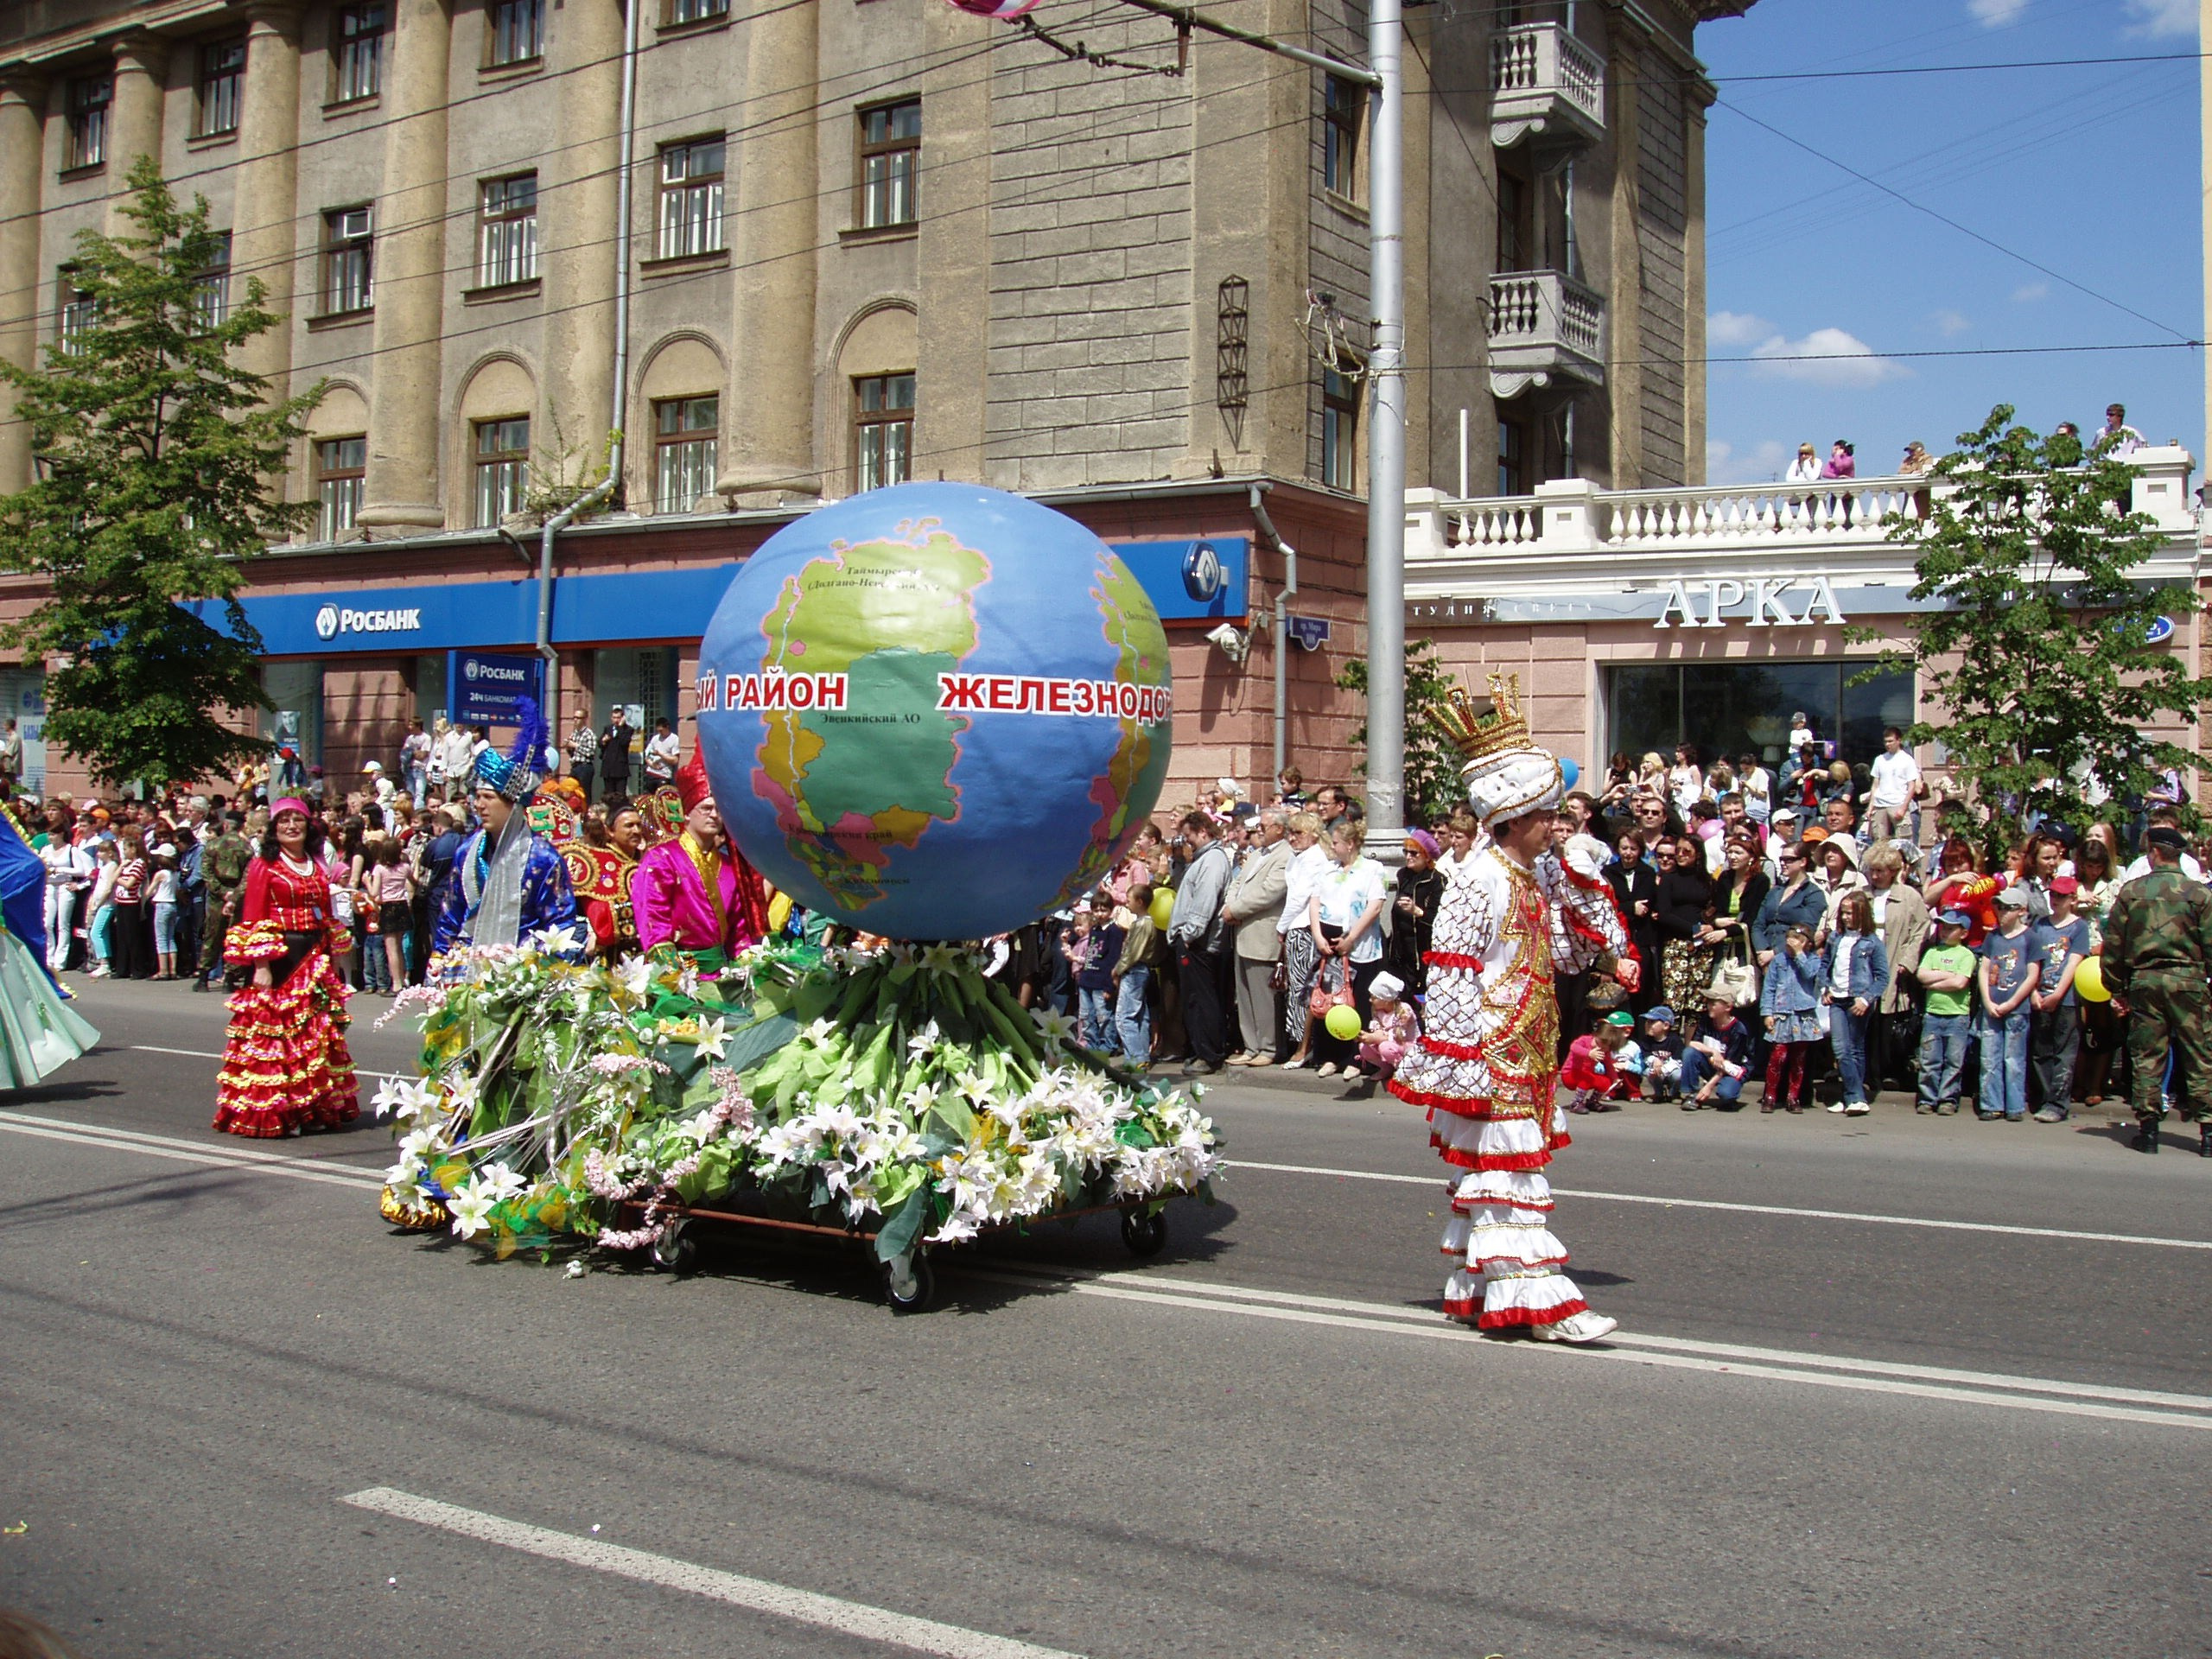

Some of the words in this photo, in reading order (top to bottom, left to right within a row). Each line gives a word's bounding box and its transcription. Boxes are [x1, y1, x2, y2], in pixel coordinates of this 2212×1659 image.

[1414, 604, 1494, 616] ТУДИЯ
[1653, 576, 1847, 628] АРКА
[340, 608, 421, 632] РОСБАНК
[480, 665, 524, 681] РОСБАНК
[726, 667, 848, 710] РАЙОН
[821, 713, 896, 724] Эвенкийский
[901, 714, 920, 724] АО
